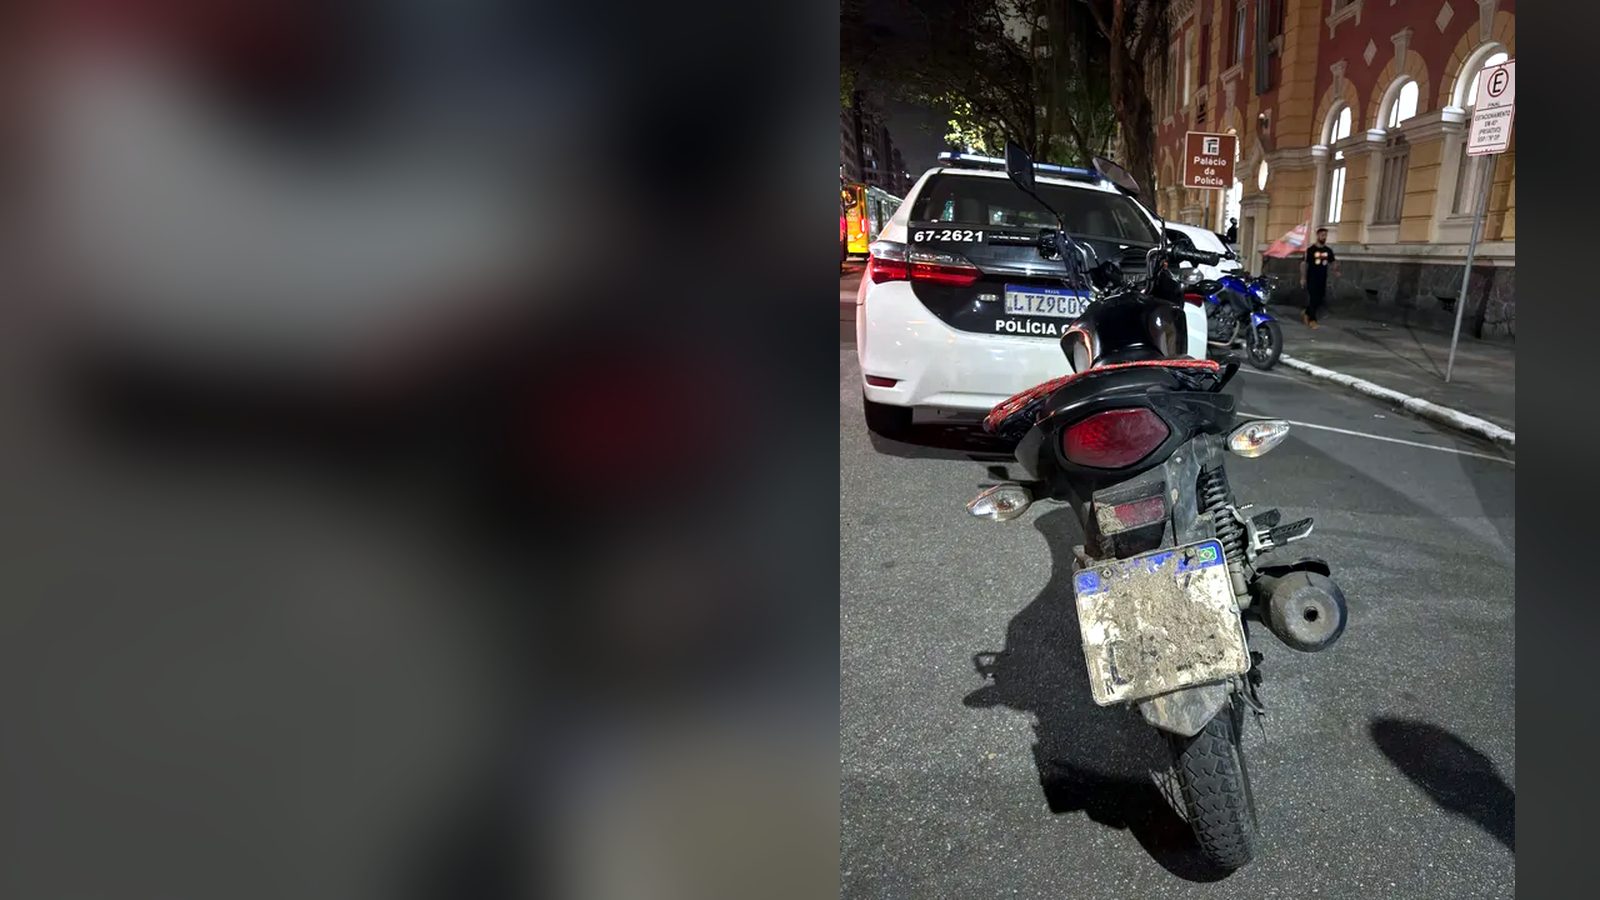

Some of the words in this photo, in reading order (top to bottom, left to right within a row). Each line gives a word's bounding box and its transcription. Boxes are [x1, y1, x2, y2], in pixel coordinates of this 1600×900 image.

[1193, 156, 1227, 166] Palácio
[1204, 167, 1215, 175] da
[914, 230, 983, 242] 67-2621
[995, 319, 1057, 335] POLÍCIA
